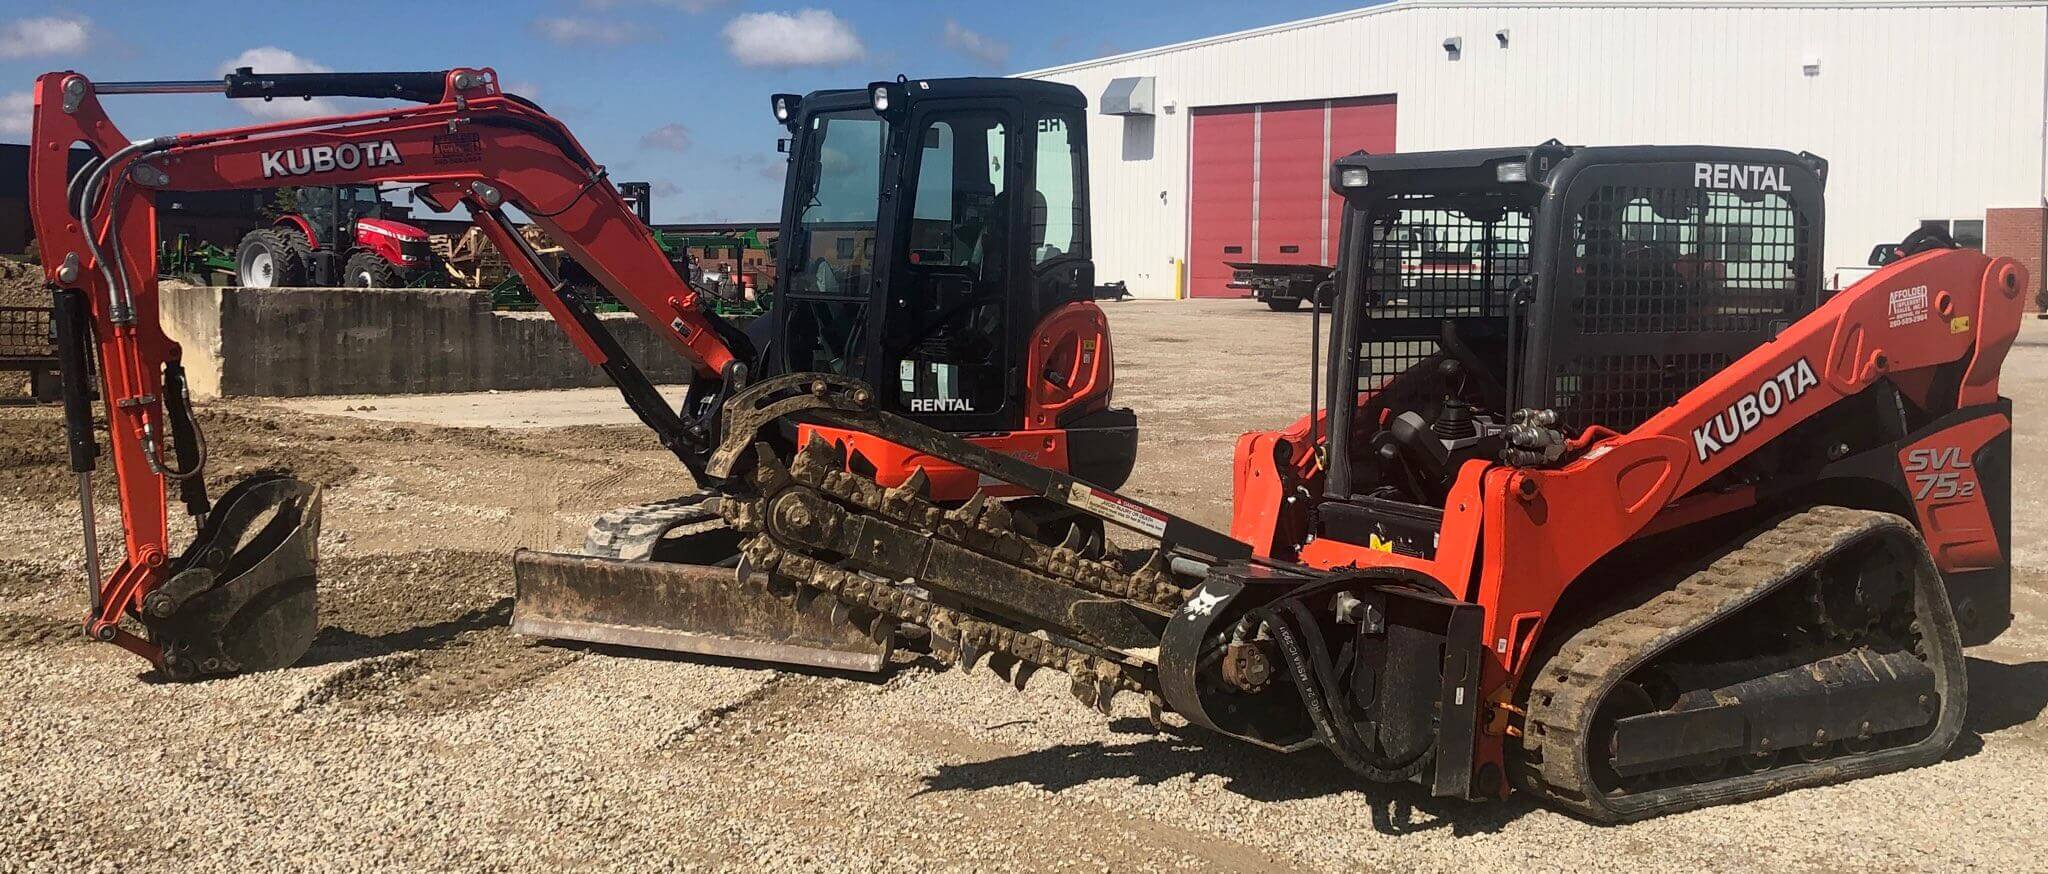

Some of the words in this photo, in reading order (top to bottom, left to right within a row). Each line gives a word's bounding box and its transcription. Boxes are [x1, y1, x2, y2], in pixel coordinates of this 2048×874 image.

[260, 139, 402, 179] KUBOTA
[1694, 162, 1792, 191] RENTAL
[911, 398, 974, 412] RENTAL
[1693, 358, 1818, 462] KUBOTA
[1905, 446, 1972, 471] SVL
